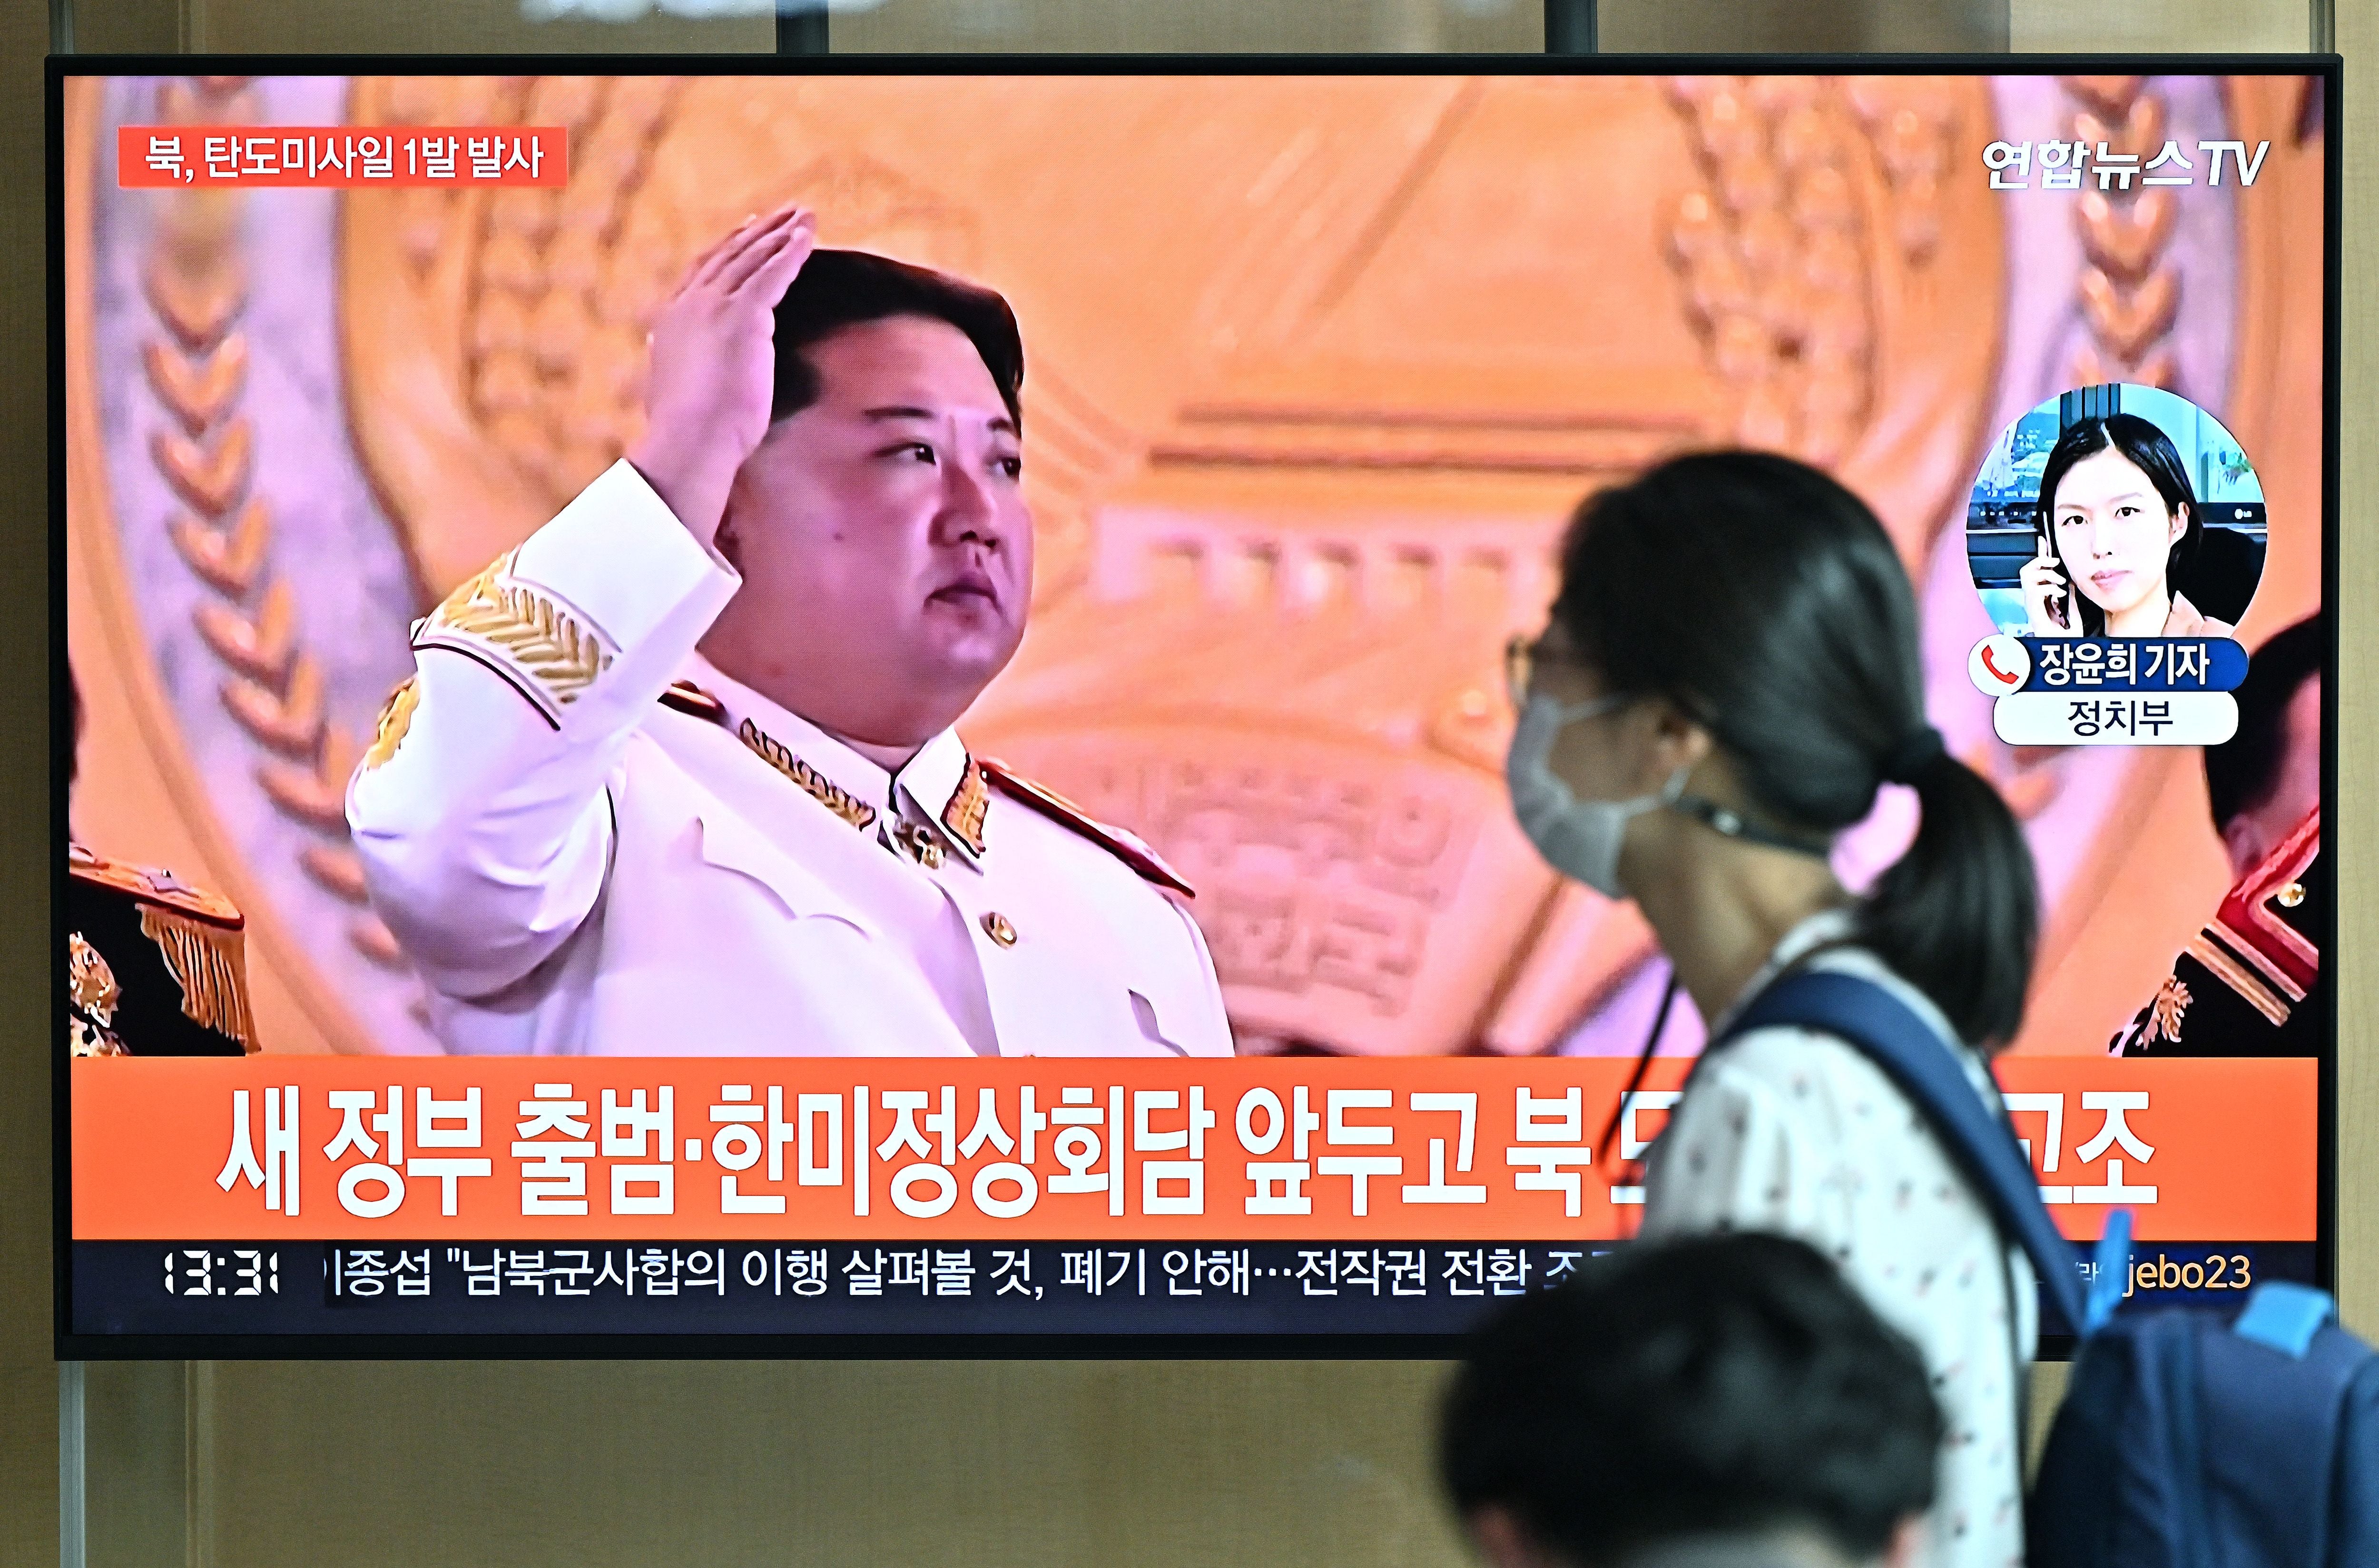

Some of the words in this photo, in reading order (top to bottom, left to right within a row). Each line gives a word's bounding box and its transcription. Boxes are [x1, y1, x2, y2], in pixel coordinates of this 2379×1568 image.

[145, 136, 194, 184] 북,
[204, 136, 393, 179] 탄도미사일
[403, 137, 460, 178] 1발
[468, 136, 544, 179] 발사
[1982, 139, 2270, 190] 연합뉴스TV
[2039, 642, 2136, 686] 장윤희
[2144, 643, 2210, 685] 기자
[2068, 700, 2173, 736] 정치부
[215, 1085, 300, 1216] 새
[323, 1085, 492, 1218] 정부
[1235, 1085, 1487, 1216] 앞두고
[1506, 1087, 1592, 1217] 북
[165, 1249, 279, 1296] 13:31
[447, 1248, 725, 1296] "남북군사합의
[742, 1248, 827, 1296] 이행
[841, 1248, 976, 1296] 살펴볼
[989, 1248, 1043, 1301] 것,
[1060, 1248, 1146, 1296] 폐기
[1441, 1248, 1533, 1296] 전환
[2122, 1254, 2251, 1298] jebo23
